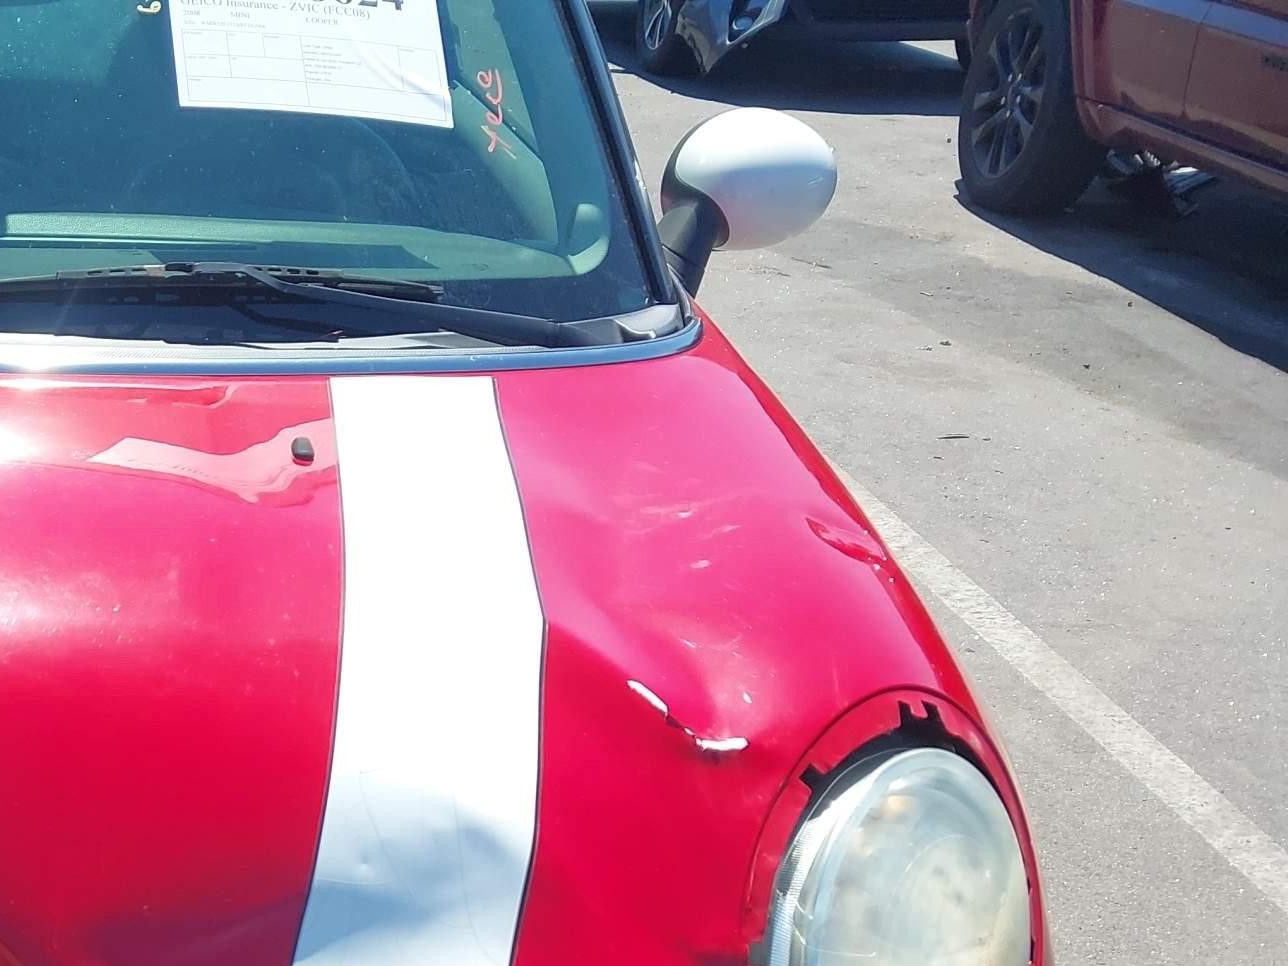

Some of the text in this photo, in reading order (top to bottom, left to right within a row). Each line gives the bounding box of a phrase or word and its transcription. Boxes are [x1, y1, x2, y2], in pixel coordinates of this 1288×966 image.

[226, 0, 279, 10] Insurance
[290, 2, 320, 12] ZVIC
[324, 5, 371, 19] (FCC08)
